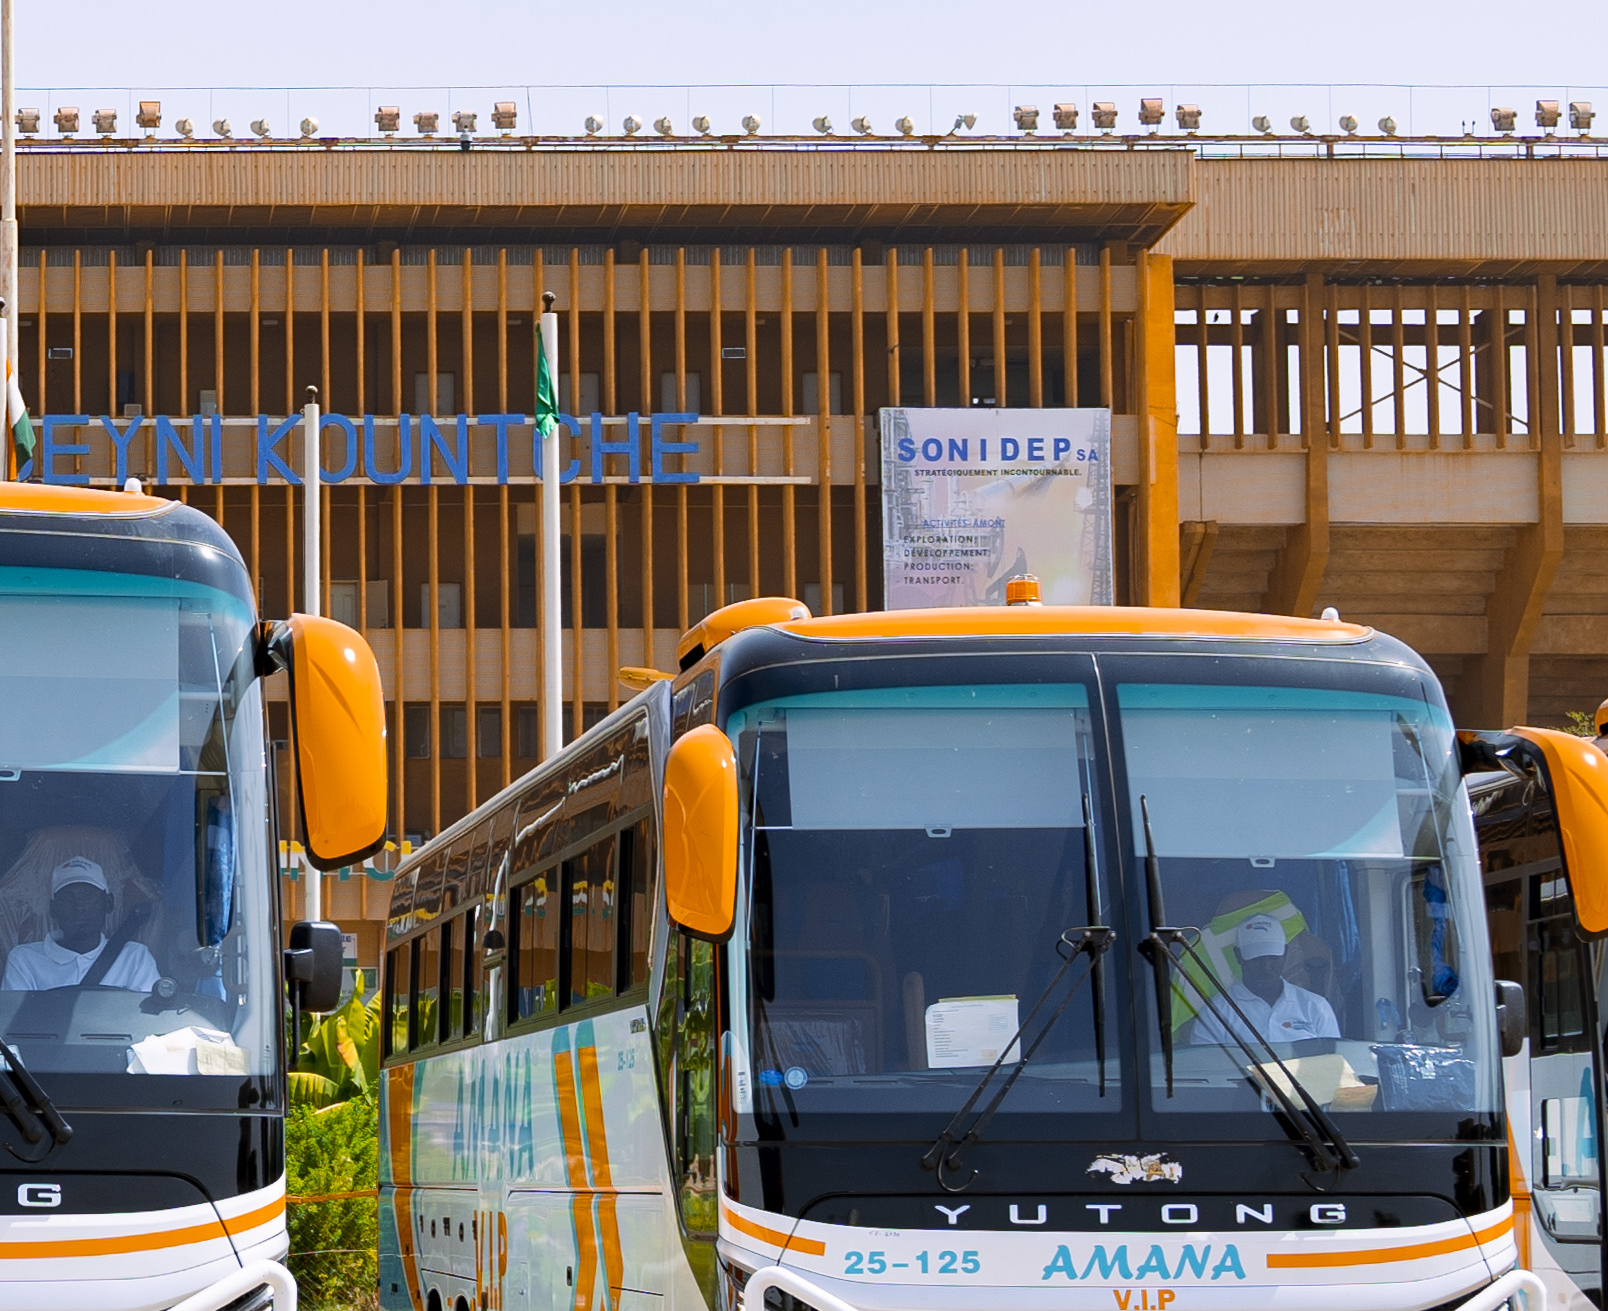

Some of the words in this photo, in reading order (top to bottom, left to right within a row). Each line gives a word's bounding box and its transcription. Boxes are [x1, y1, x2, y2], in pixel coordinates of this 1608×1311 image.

[934, 1203, 1349, 1227] YUTONG
[844, 1250, 982, 1275] 25-125
[1041, 1244, 1248, 1282] AMANA
[1112, 1289, 1177, 1311] V.I.P
